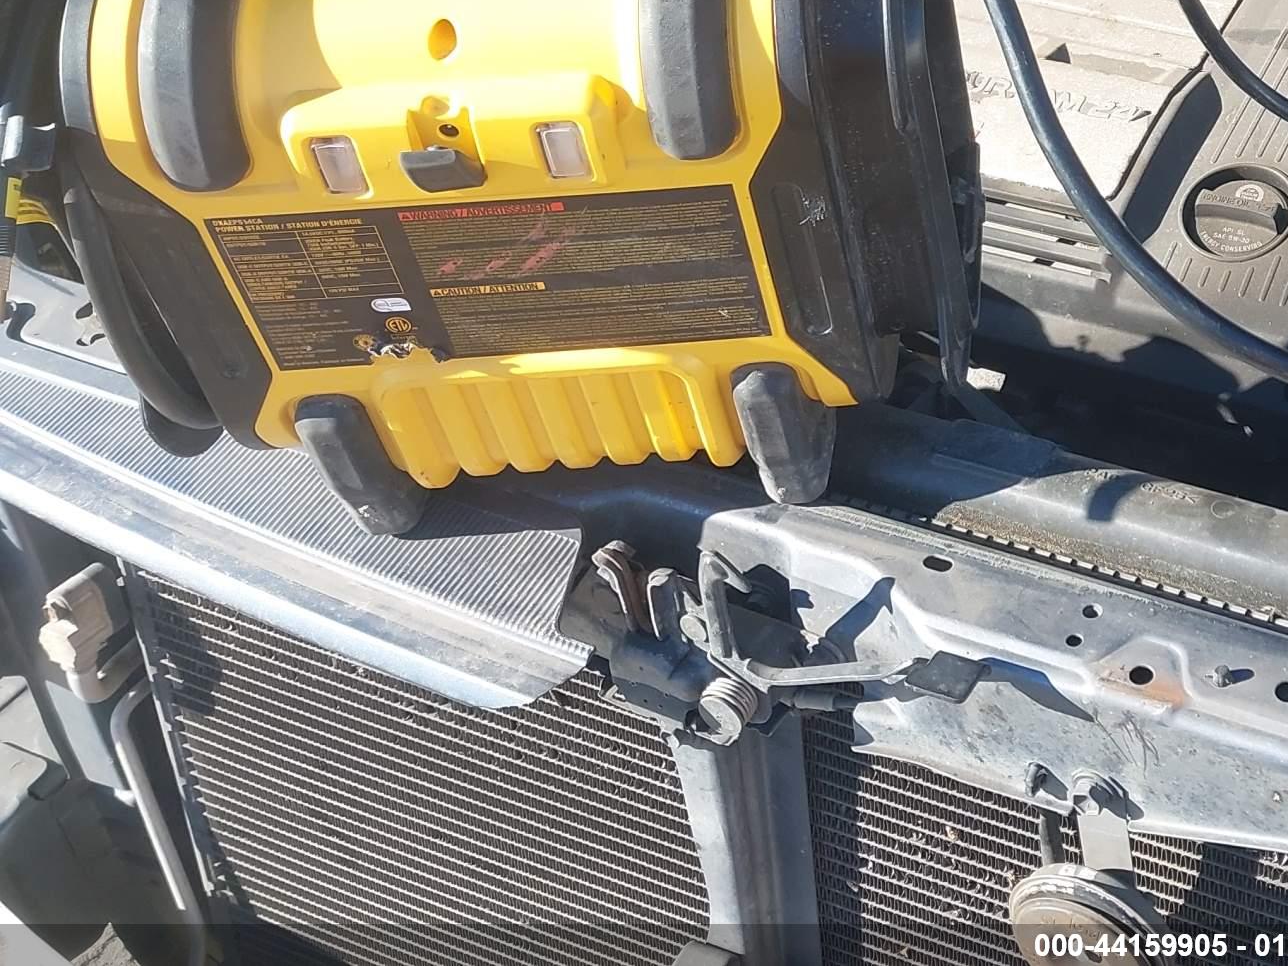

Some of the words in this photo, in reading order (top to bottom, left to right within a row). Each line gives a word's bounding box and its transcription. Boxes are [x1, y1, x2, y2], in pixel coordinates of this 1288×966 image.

[411, 209, 457, 220] WARNING
[214, 225, 244, 233] POWER
[245, 223, 280, 232] STATION
[286, 221, 320, 230] STATION
[441, 287, 482, 297] CAUTION
[489, 282, 538, 293] ATTENTION
